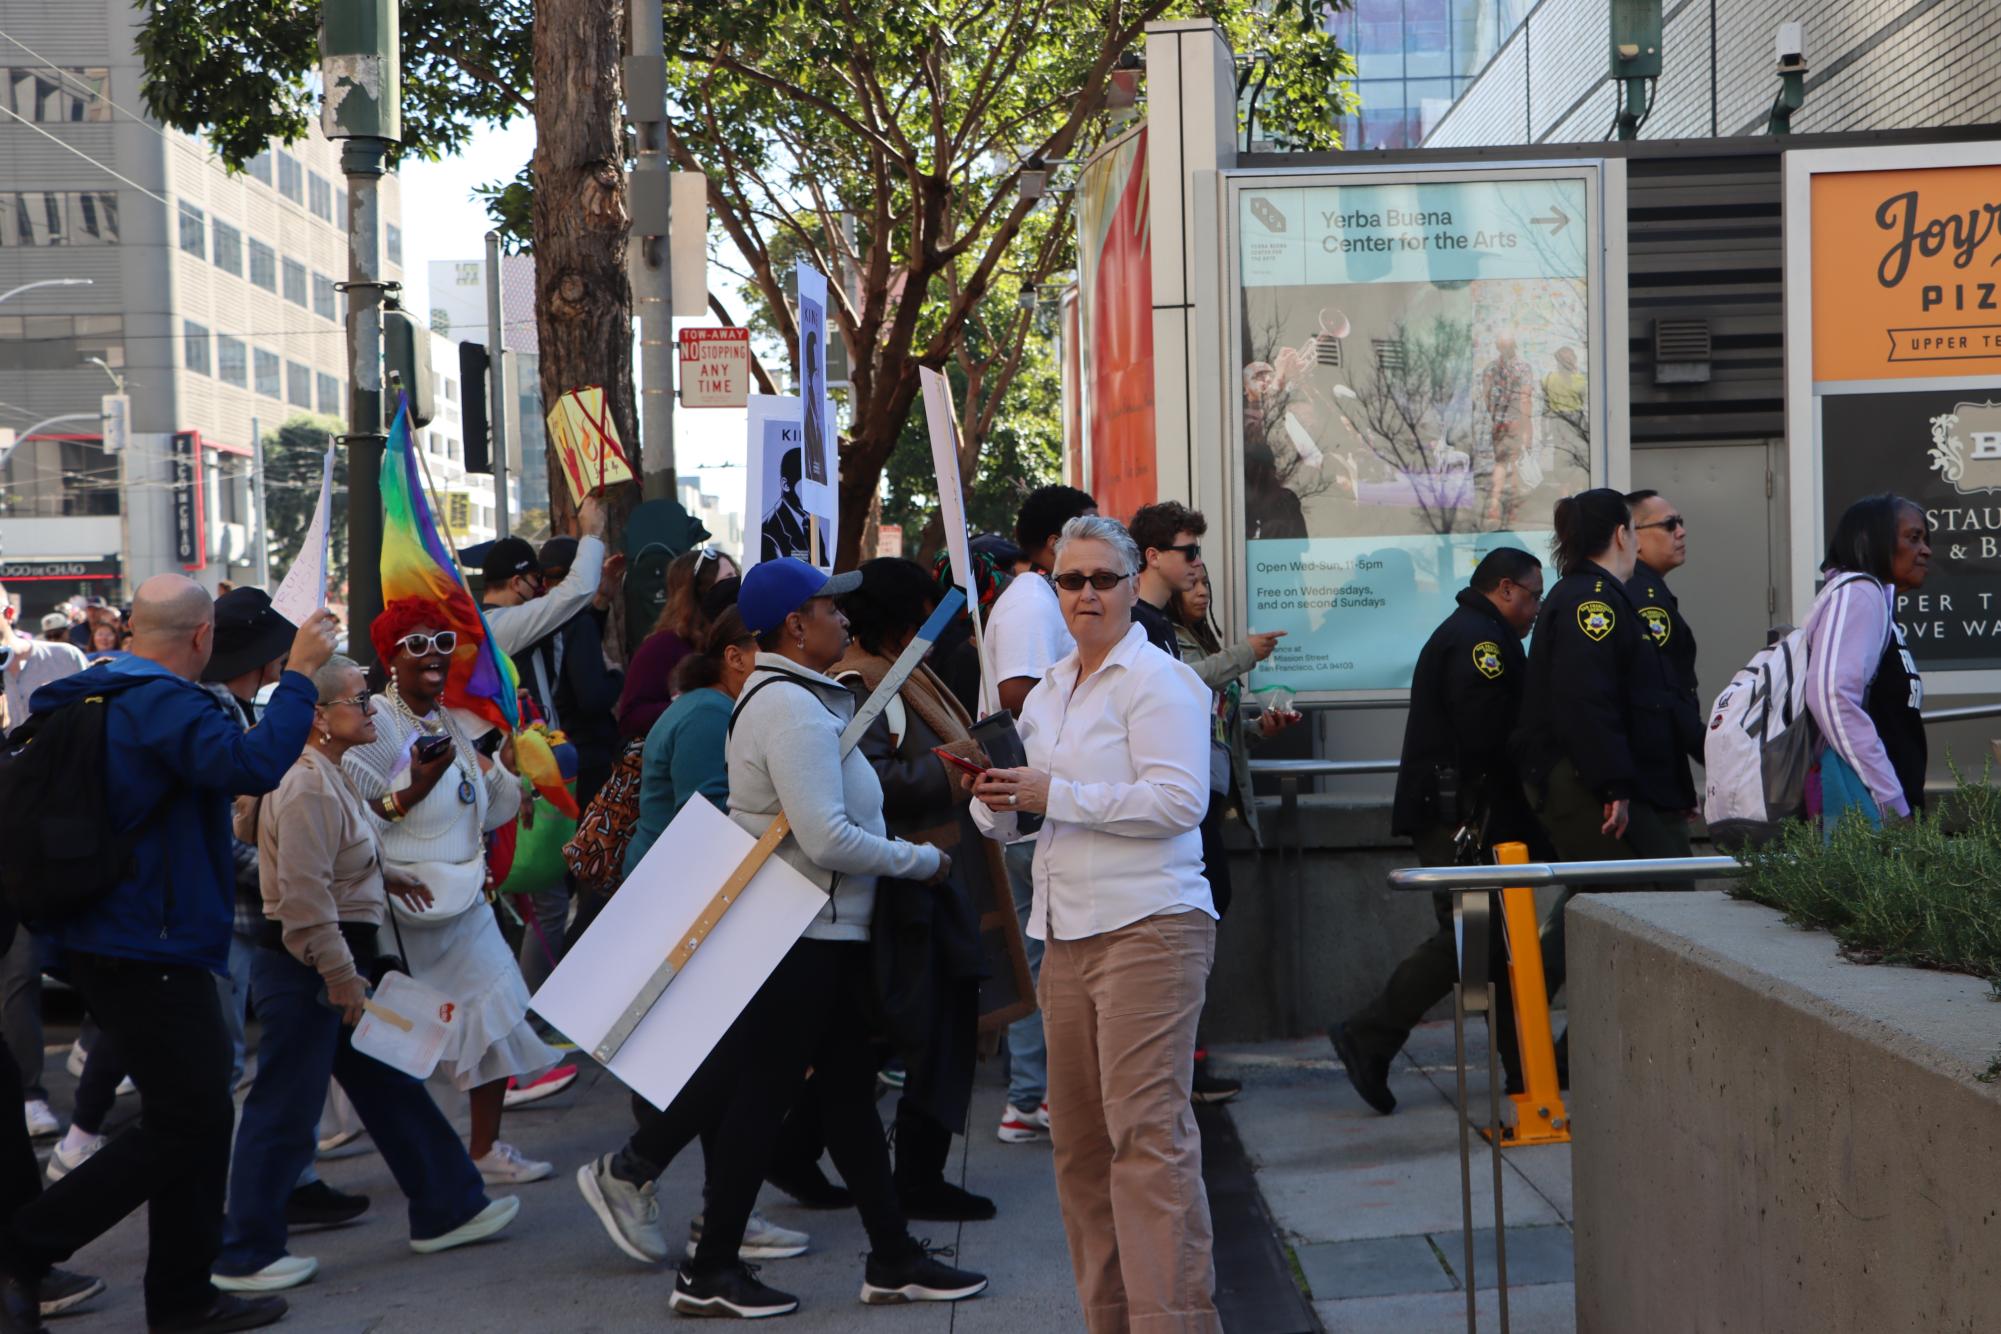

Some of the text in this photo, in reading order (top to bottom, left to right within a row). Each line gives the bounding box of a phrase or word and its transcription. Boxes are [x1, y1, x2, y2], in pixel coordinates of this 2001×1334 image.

[1321, 209, 1453, 229] Yerba Buena
[1322, 230, 1517, 253] Center for the Arts
[1922, 283, 1997, 312] PIZ
[805, 308, 818, 328] KIN
[683, 330, 744, 339] TOW-AWAY
[1912, 335, 2001, 350] UPPER TE
[681, 341, 746, 360] NO STOPPING
[701, 364, 728, 376] ANY
[698, 380, 732, 393] TIME
[782, 429, 801, 442] KI
[1970, 432, 2001, 460] B
[1926, 508, 2001, 531] STAU
[1950, 536, 2001, 559] & B
[0, 564, 31, 576] OGO
[1256, 559, 1383, 573] Open Wed-Sun, 11-5pm
[1257, 585, 1373, 597] Free on Wednesdays,
[1257, 597, 1386, 610] and on second Sundays
[1897, 592, 1993, 612] PER T
[1962, 618, 2001, 637] WA
[1274, 654, 1304, 662] Mission
[1305, 653, 1329, 662] Street
[1260, 661, 1354, 672] San Francisco, CA 94103
